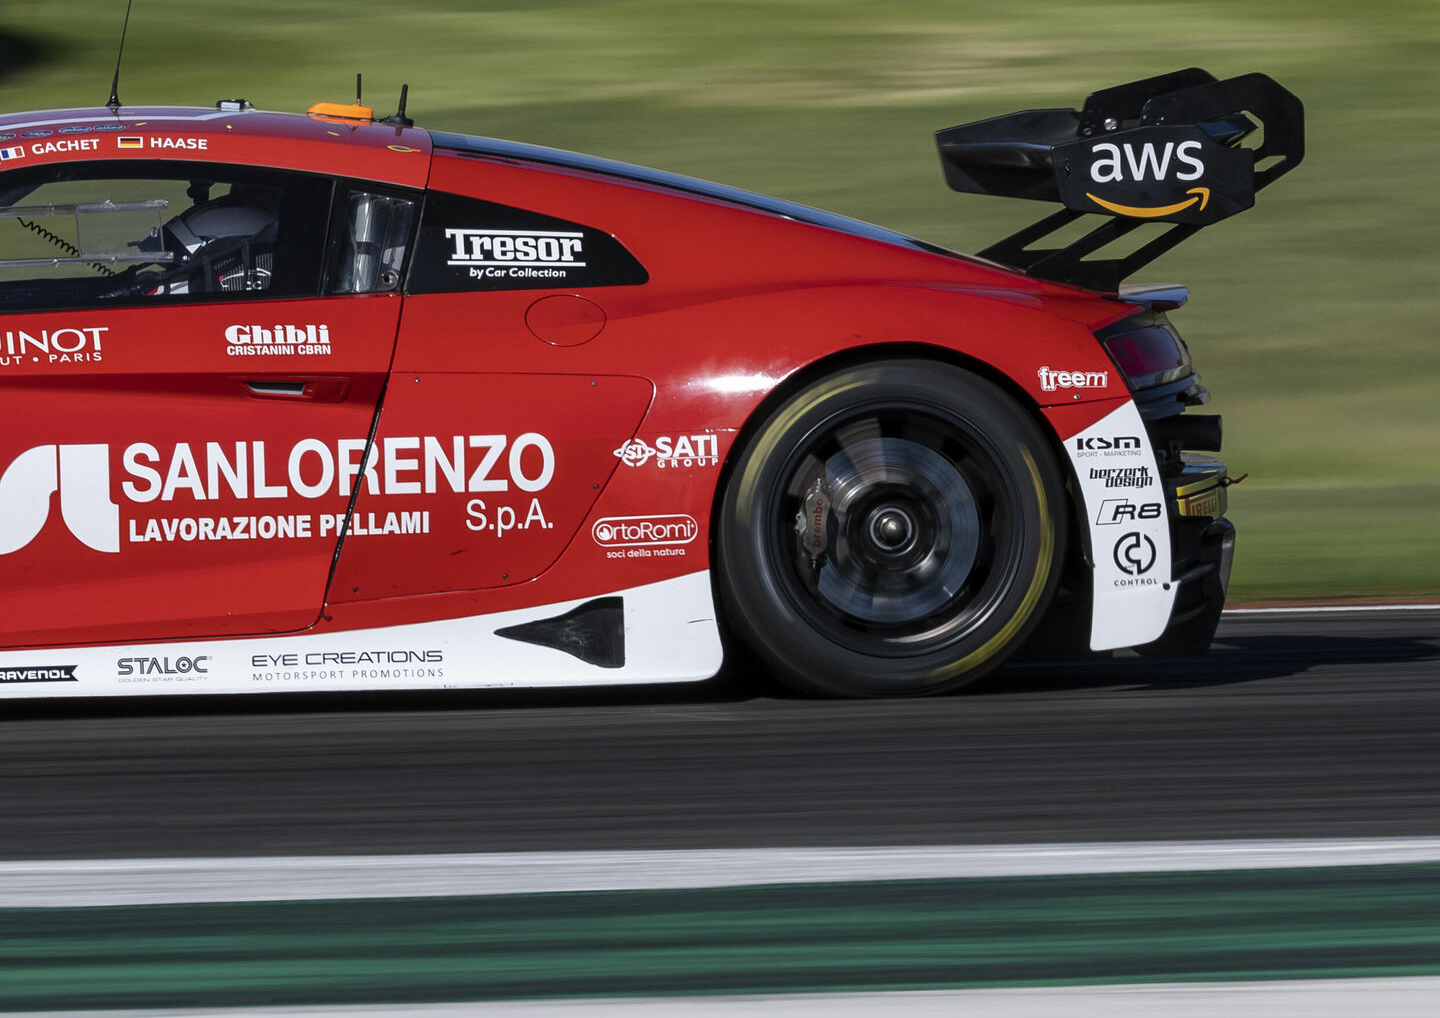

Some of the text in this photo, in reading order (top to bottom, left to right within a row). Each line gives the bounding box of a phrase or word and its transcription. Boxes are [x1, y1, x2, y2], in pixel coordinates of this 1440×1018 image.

[32, 139, 100, 155] GACHET
[151, 137, 208, 150] HAASE
[1090, 140, 1205, 183] aws
[445, 228, 584, 262] Tresor
[469, 267, 566, 279] by Car Collection
[224, 324, 331, 344] Ghibli
[226, 344, 331, 356] CRISTANINI CBRN
[49, 352, 103, 363] PARIS
[655, 434, 718, 458] SATI
[1104, 449, 1142, 457] MARKETING
[121, 432, 556, 503] SANLORENZO
[657, 457, 719, 469] GROUP
[1089, 466, 1149, 479] berzerk
[1105, 476, 1153, 488] design
[465, 498, 554, 537] S.p.A.
[128, 510, 430, 543] LAVORAZIONE PELLAMI
[596, 520, 691, 541] OrtoRomi
[606, 548, 685, 559] soci della natura
[1113, 578, 1158, 587] CONTROL
[117, 655, 208, 675] STALOC
[251, 650, 443, 667] EYE CREATIONS
[252, 668, 444, 681] MOTORSPORT PROMOTIONS
